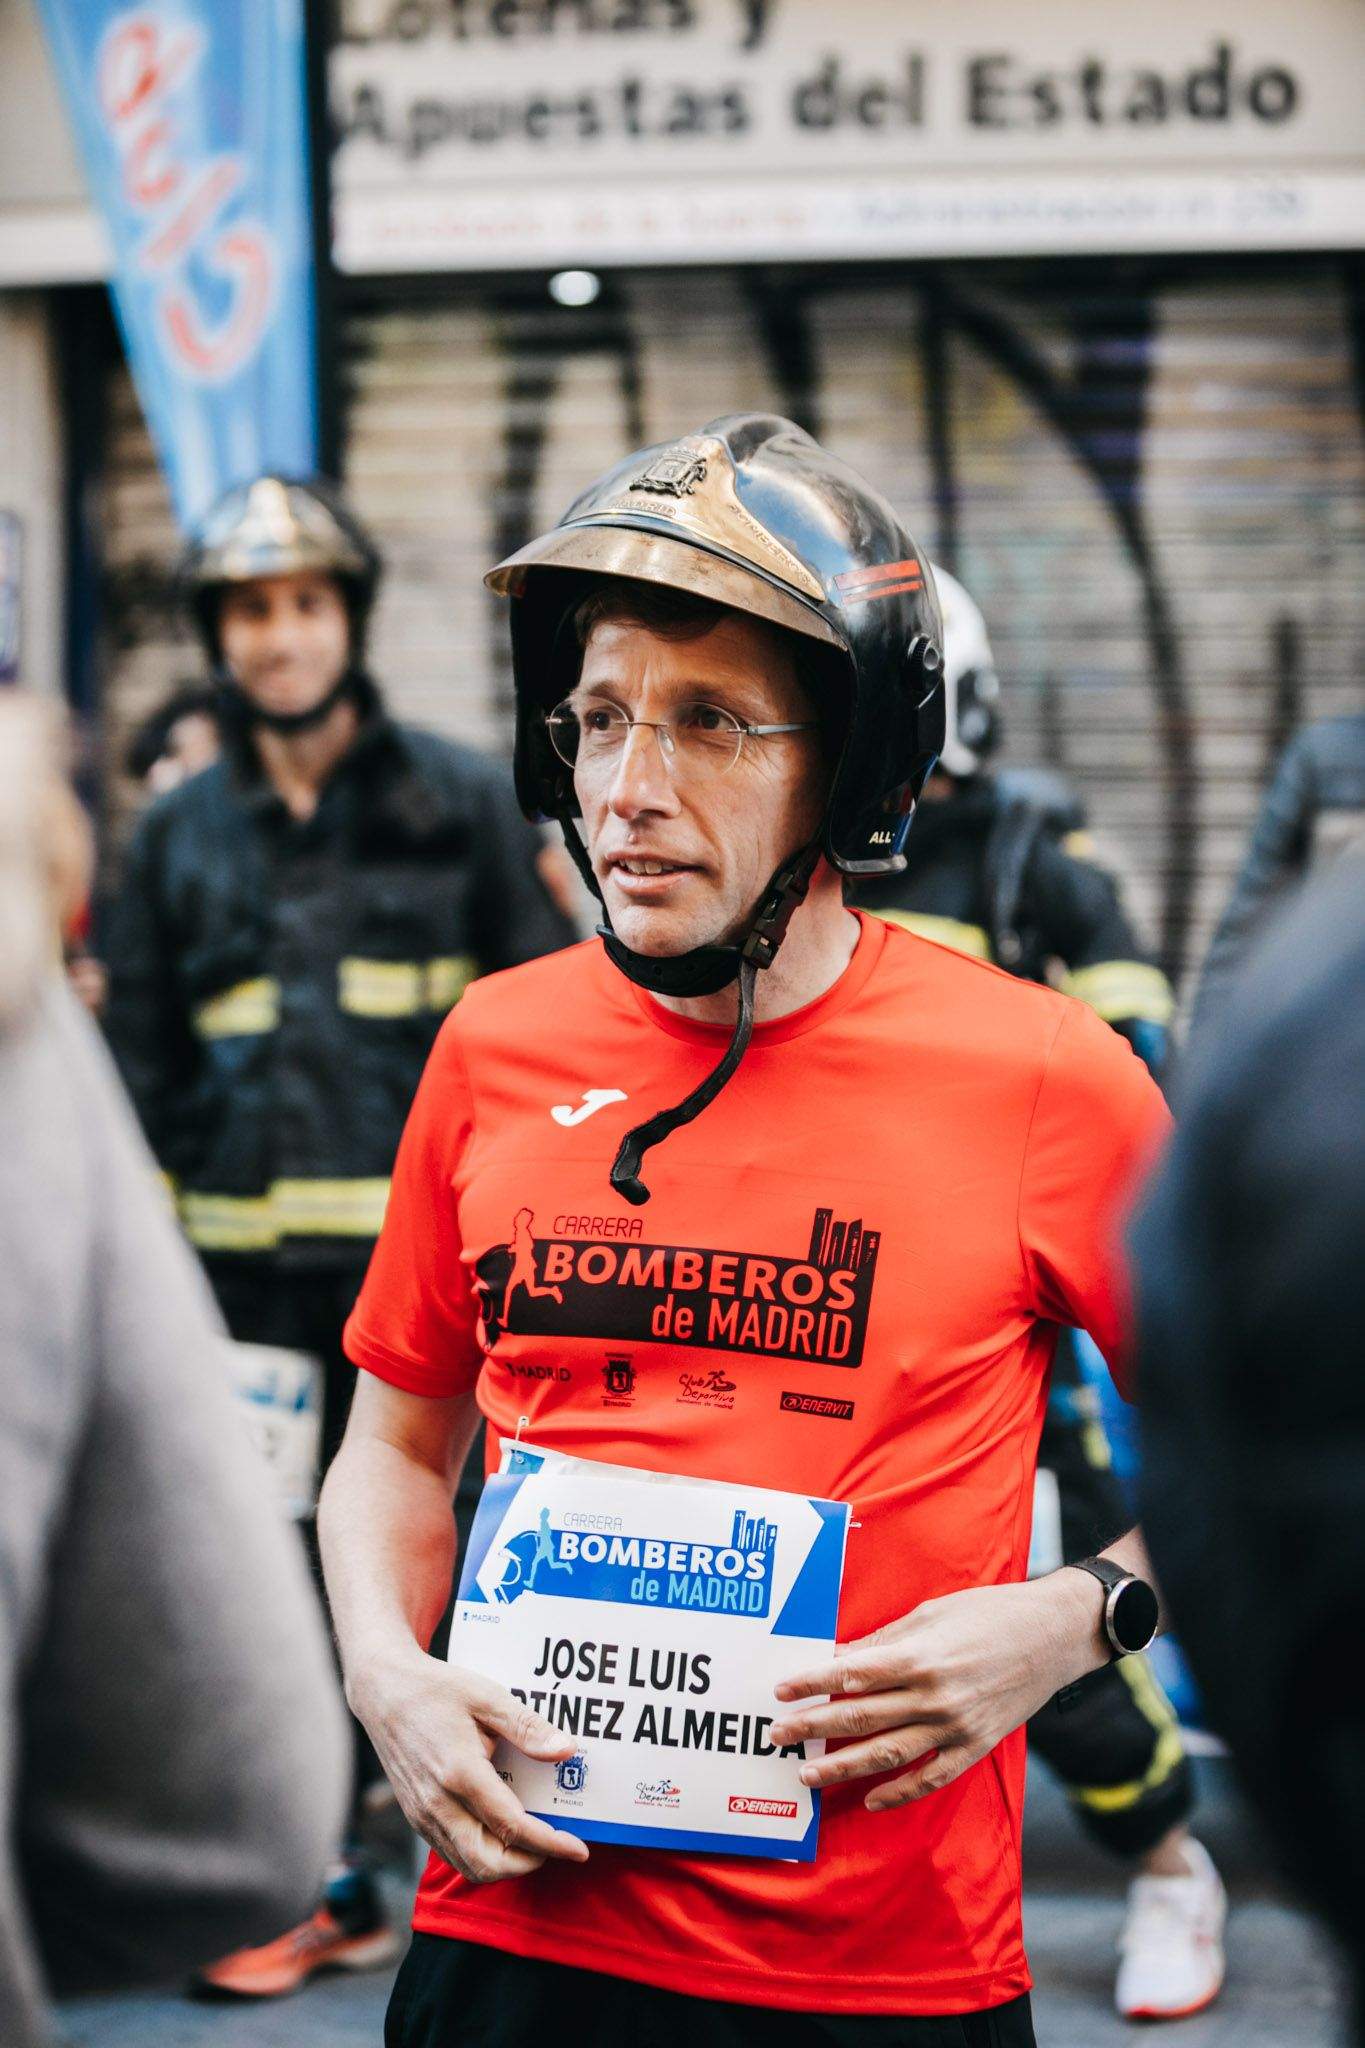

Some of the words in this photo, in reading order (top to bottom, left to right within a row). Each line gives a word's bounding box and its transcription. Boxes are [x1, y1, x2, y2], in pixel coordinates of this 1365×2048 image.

[347, 74, 750, 160] Apuestas
[796, 52, 923, 130] del
[965, 42, 1298, 131] Estado
[553, 1215, 643, 1238] CARRERA
[543, 1243, 858, 1310] BOMBEROS
[651, 1294, 694, 1340] de
[707, 1298, 853, 1360] MADRID
[516, 1365, 571, 1381] MADRID
[679, 1374, 704, 1387] Club
[803, 1398, 852, 1417] ENERVIT
[563, 1512, 623, 1531] CARRERA
[559, 1531, 766, 1580] BOMBEROS
[631, 1570, 660, 1601] de
[667, 1573, 765, 1613] MADRID
[471, 1613, 500, 1623] MADRID
[533, 1636, 619, 1684] JOSE
[629, 1647, 712, 1694] LUIS
[748, 1799, 796, 1816] ENERVIT
